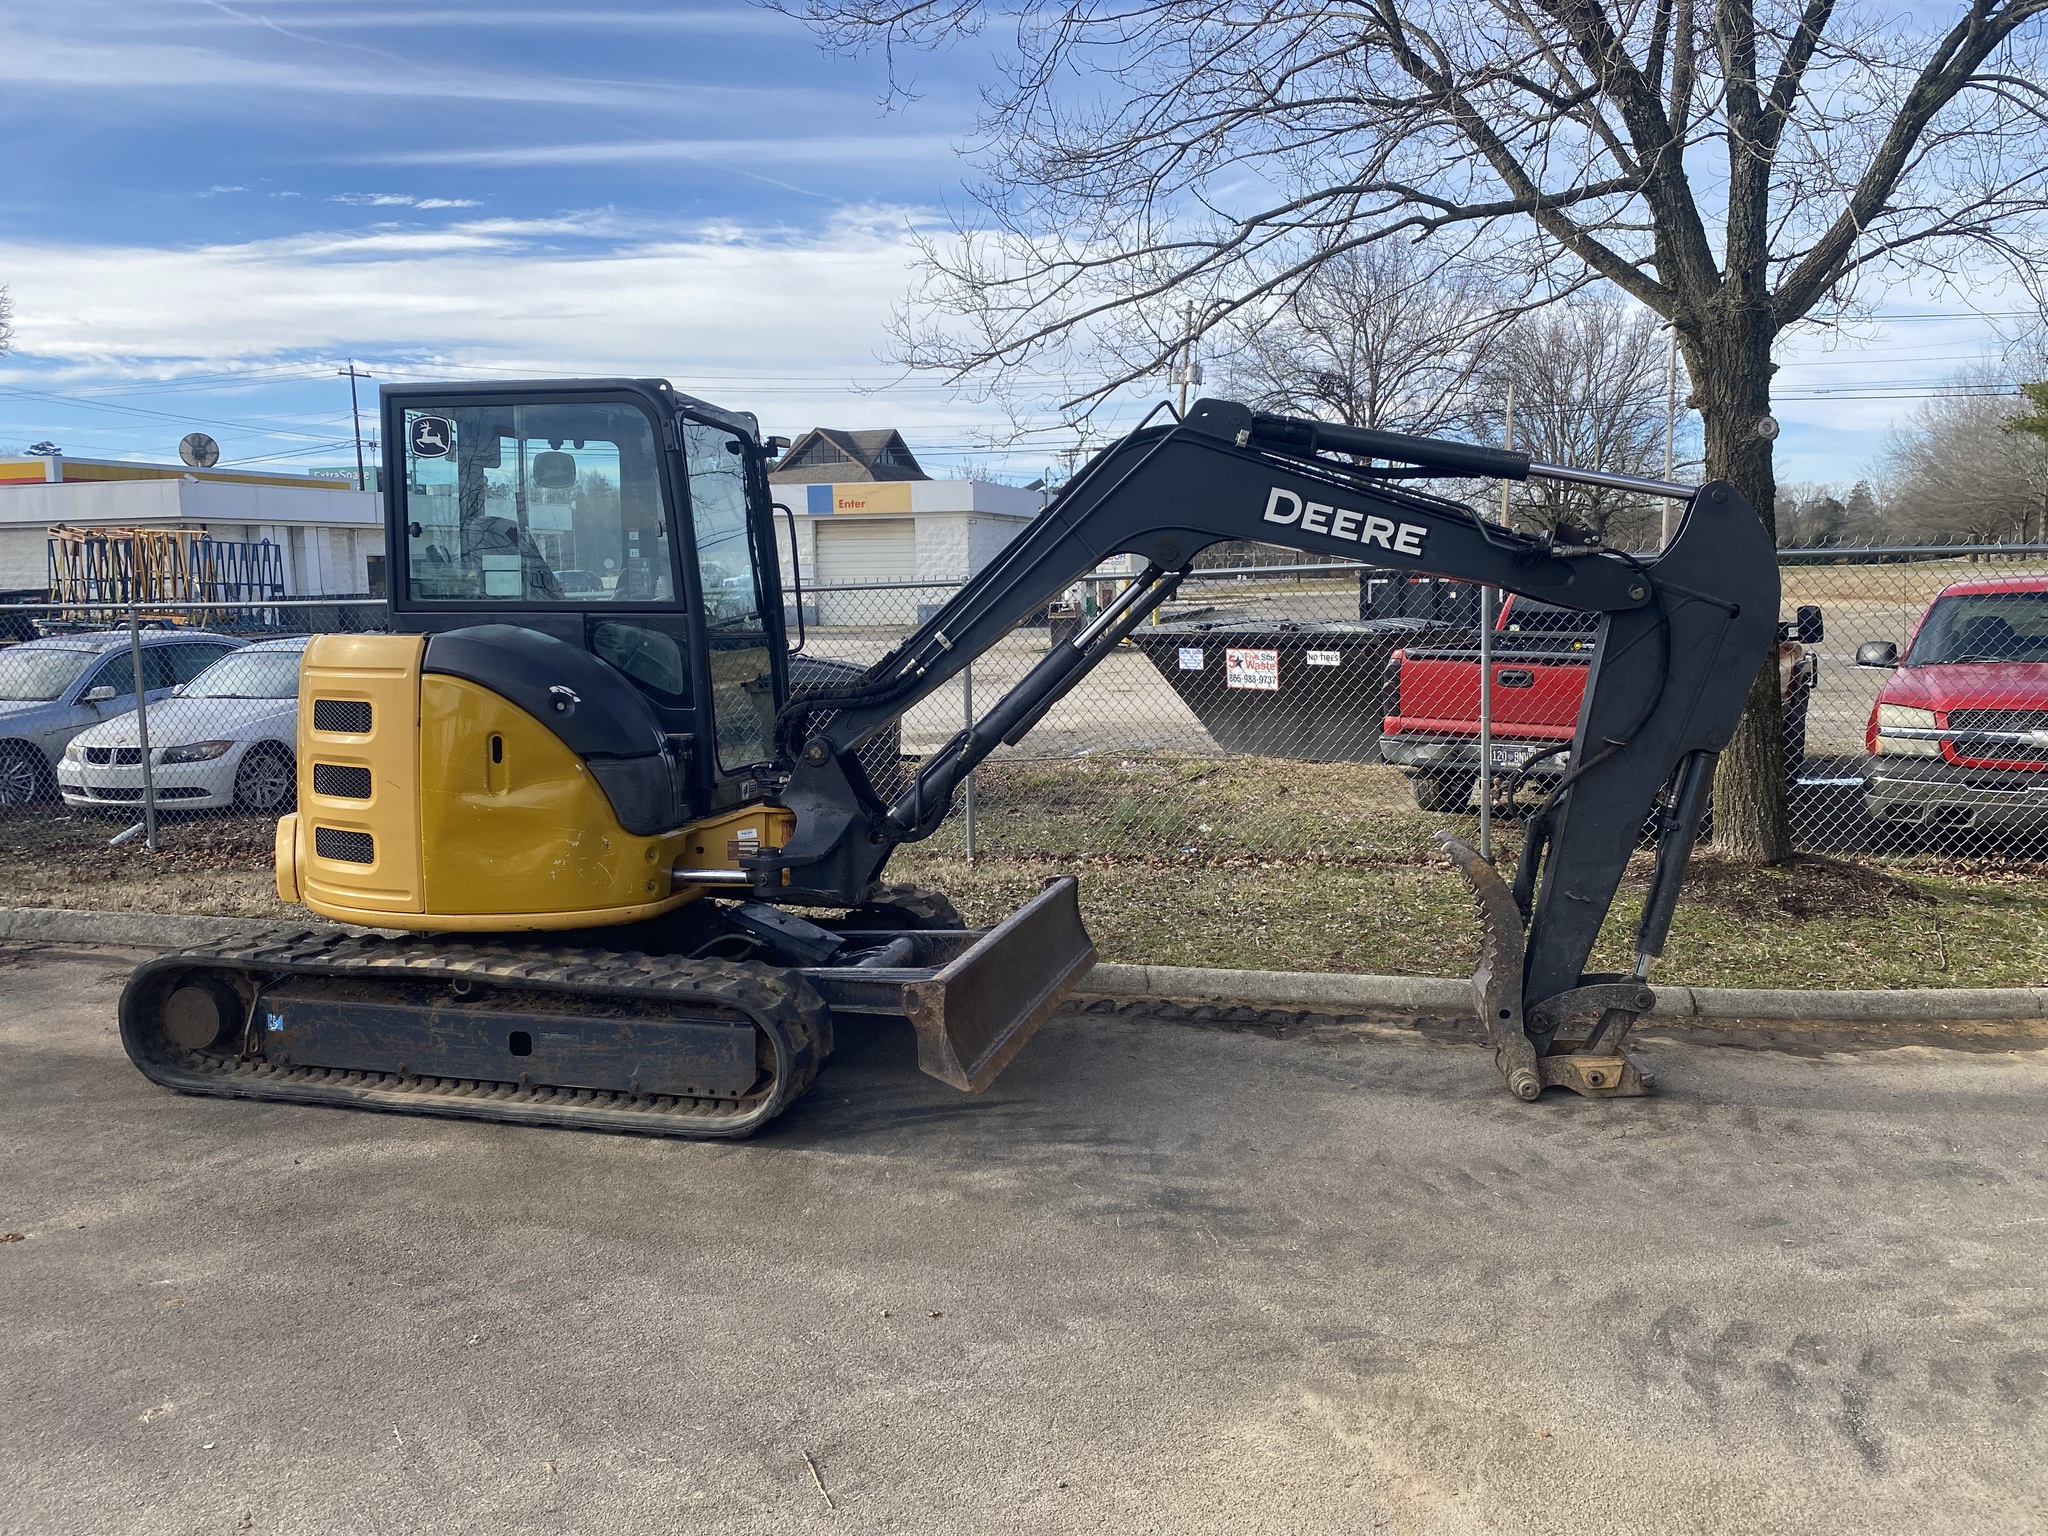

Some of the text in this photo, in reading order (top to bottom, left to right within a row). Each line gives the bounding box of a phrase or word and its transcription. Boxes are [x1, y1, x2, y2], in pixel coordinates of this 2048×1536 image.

[838, 499, 865, 508] Enter
[1263, 486, 1428, 556] DEERE
[1229, 655, 1236, 668] 5
[1245, 652, 1276, 661] Five Star
[1308, 653, 1318, 661] NO
[1245, 659, 1276, 671] Waste
[1493, 750, 1507, 761] 120
